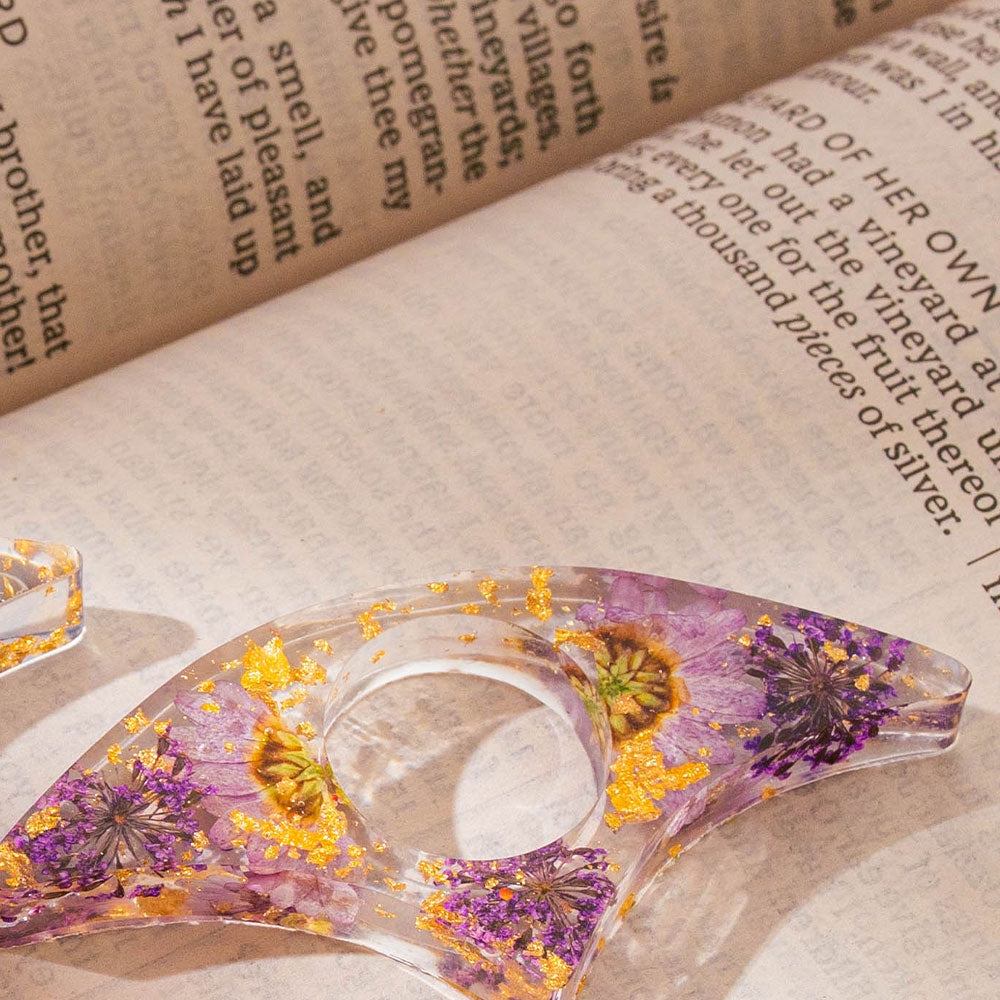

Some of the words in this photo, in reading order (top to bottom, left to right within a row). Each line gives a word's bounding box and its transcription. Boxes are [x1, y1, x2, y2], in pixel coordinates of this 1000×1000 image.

[176, 26, 204, 45] I
[231, 56, 269, 94] of
[186, 51, 231, 143] have
[363, 66, 400, 149] thee
[428, 3, 476, 116] hether
[460, 124, 488, 183] the
[565, 42, 600, 136] forth
[939, 102, 973, 131] in
[217, 149, 256, 222] laid
[240, 106, 301, 262] pleasant
[269, 41, 324, 160] smell,
[306, 177, 342, 246] and
[381, 157, 411, 211] my
[229, 229, 259, 277] up
[772, 142, 835, 187] had
[828, 194, 854, 211] a
[858, 217, 979, 346] vineyard
[823, 133, 873, 161] OF
[863, 167, 930, 226] HER
[926, 230, 1000, 313] OWN
[39, 283, 71, 358] that
[718, 194, 772, 235] one
[766, 237, 816, 276] for
[808, 281, 858, 329] the
[851, 334, 921, 405] fruit
[722, 149, 765, 179] let
[763, 184, 818, 224] out
[813, 230, 864, 276] the
[865, 283, 985, 419] vineyard
[652, 187, 677, 203] a
[672, 201, 797, 312] thousand
[772, 314, 866, 400] pieces
[858, 406, 903, 439] of
[882, 442, 961, 536] silver.
